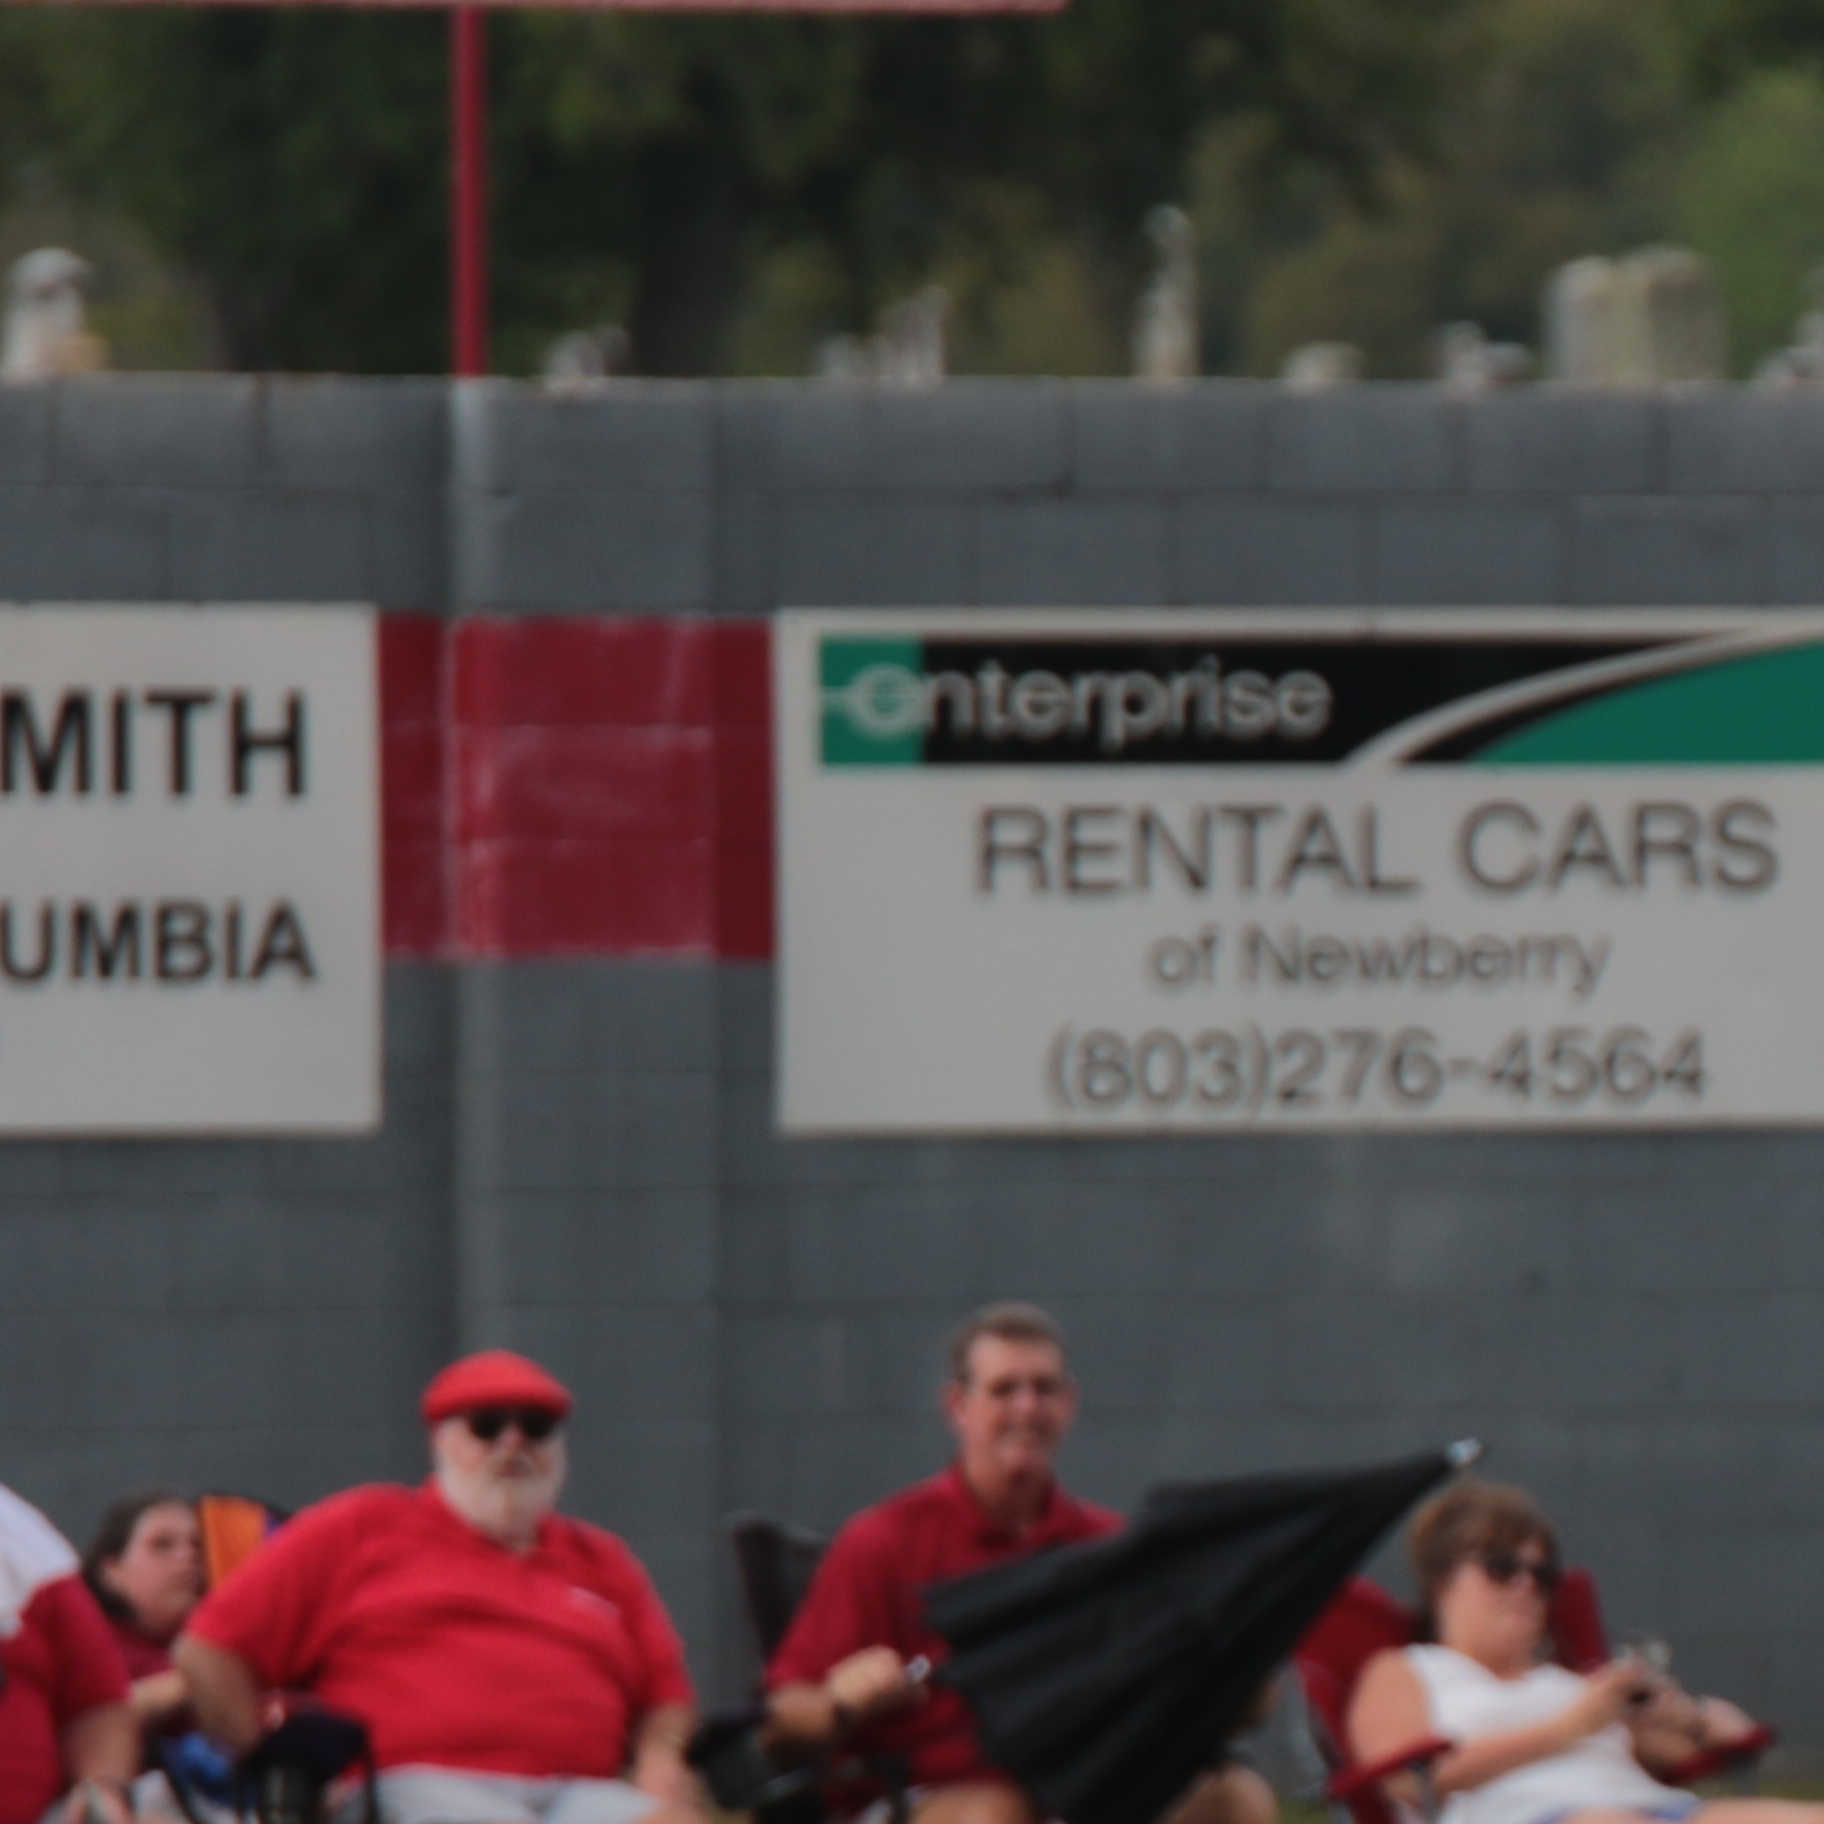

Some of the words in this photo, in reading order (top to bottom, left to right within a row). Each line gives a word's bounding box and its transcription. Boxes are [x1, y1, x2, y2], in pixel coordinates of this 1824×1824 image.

[0, 690, 305, 798] MITH
[848, 655, 1334, 754] enterprise
[975, 803, 1418, 897] RENTAL
[1456, 799, 1780, 895] CARS
[0, 900, 316, 983] UMBIA
[1148, 924, 1220, 990] of
[1242, 924, 1612, 1002] Newberry
[1046, 1022, 1710, 1117] (803)276-4564
